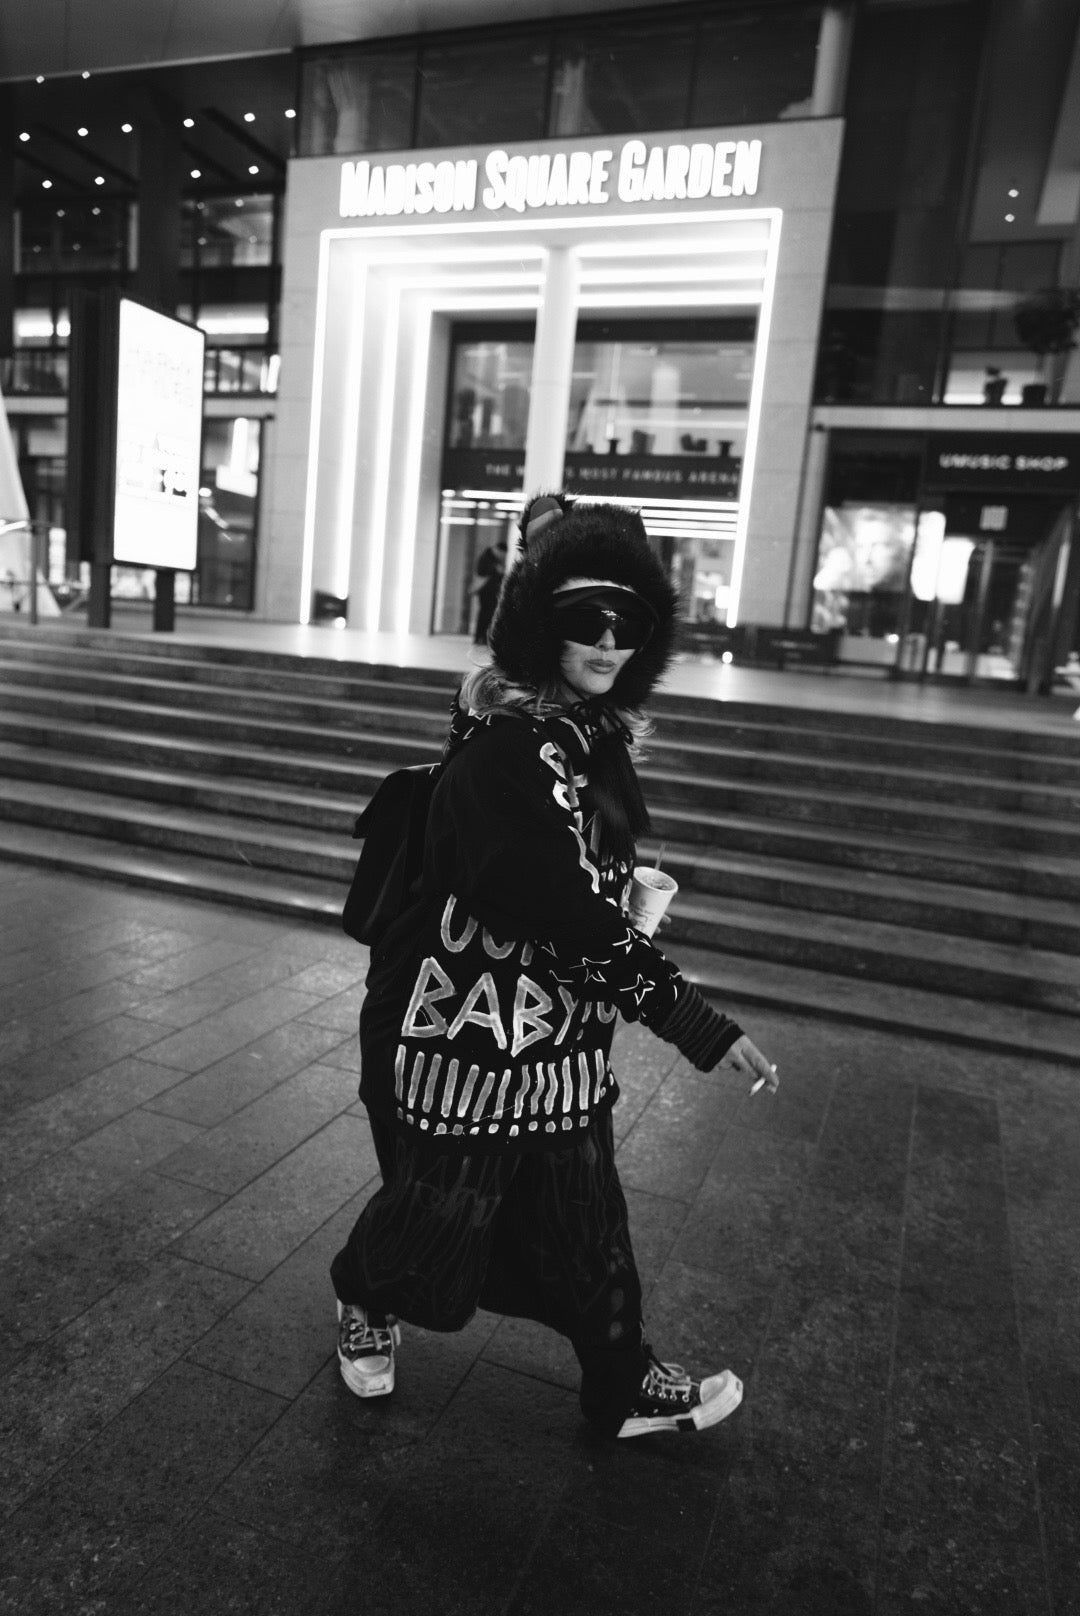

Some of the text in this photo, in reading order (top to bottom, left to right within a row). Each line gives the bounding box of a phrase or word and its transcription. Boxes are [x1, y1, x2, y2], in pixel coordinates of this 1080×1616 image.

[339, 139, 762, 217] MADISON SQUARE GARDEN
[1015, 455, 1068, 471] SHOP
[622, 467, 683, 483] FAMOUS
